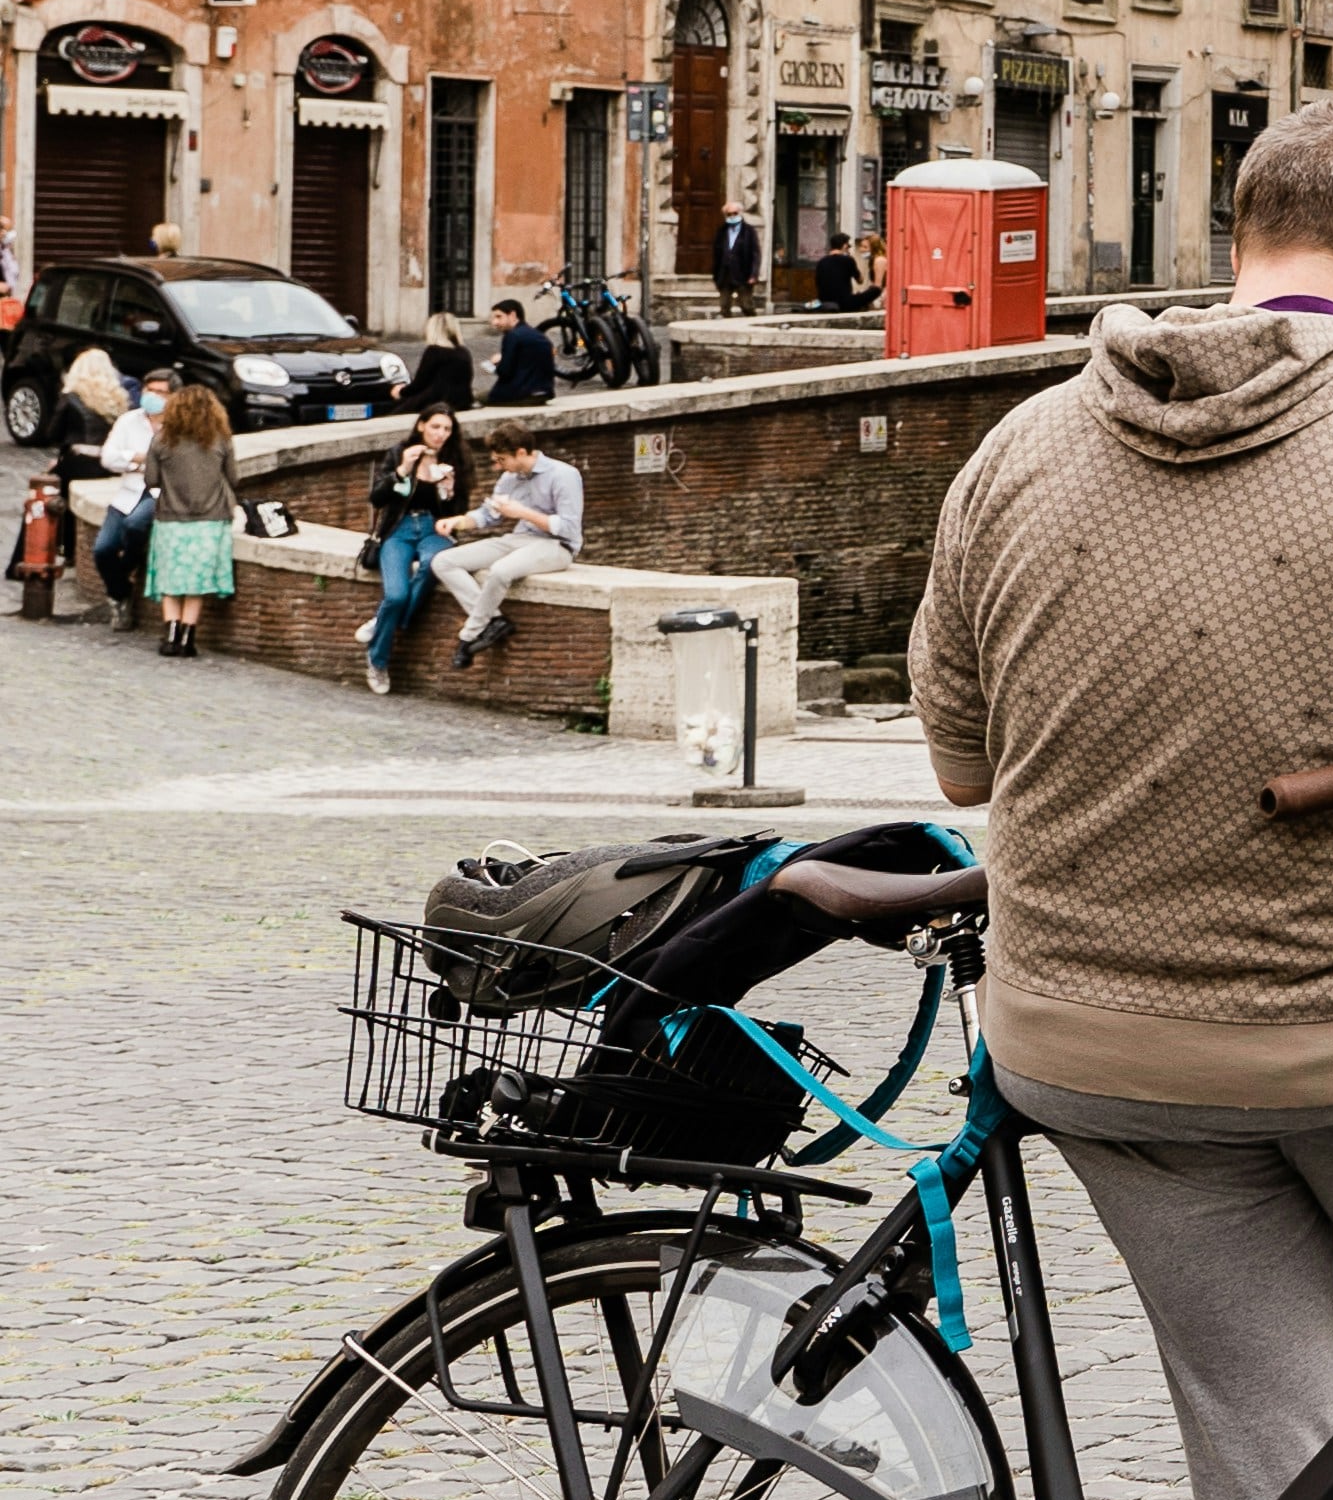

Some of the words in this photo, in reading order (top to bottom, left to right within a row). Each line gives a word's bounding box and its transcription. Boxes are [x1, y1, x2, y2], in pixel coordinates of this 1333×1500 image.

[779, 60, 845, 89] GIOREN
[1001, 58, 1067, 88] PIZZERIA
[880, 87, 954, 112] GLOVES
[1001, 1195, 1018, 1244] Gazelle
[816, 1305, 843, 1334] AXA
